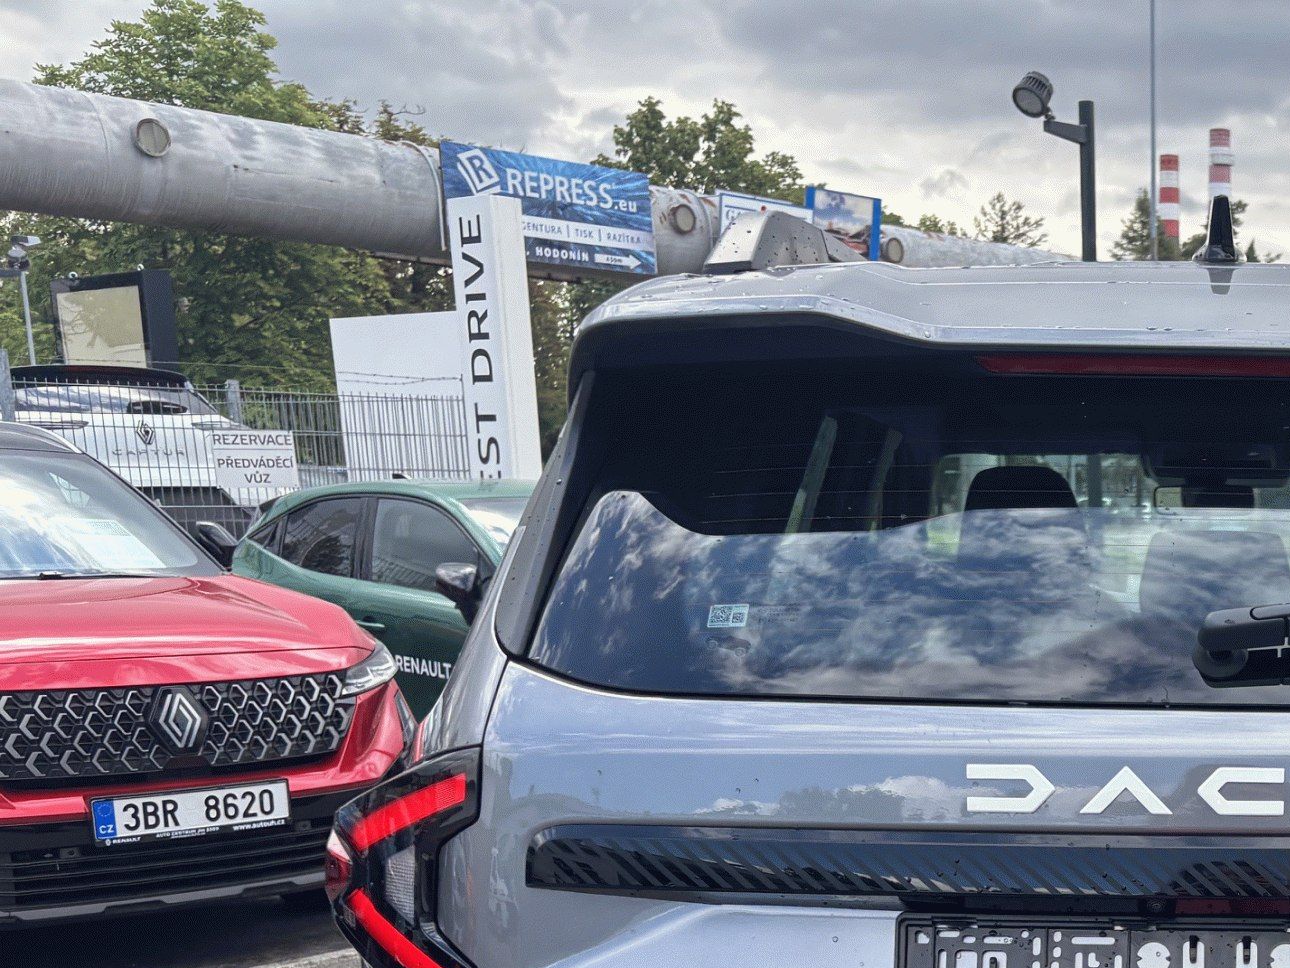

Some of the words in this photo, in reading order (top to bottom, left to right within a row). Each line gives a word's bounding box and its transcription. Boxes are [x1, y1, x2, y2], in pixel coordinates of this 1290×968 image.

[506, 167, 638, 213] REPRESS.eu
[575, 229, 594, 239] TISK
[535, 246, 589, 262] HODONÍN
[459, 214, 494, 385] DRIVE
[213, 433, 292, 447] REZERVACE
[217, 455, 294, 469] PŘEDVÁDĚCÍ
[244, 471, 271, 484] VŮZ
[395, 654, 452, 679] RENAULT
[99, 824, 115, 834] CZ
[122, 799, 180, 832] 3BR
[204, 788, 275, 822] 8620
